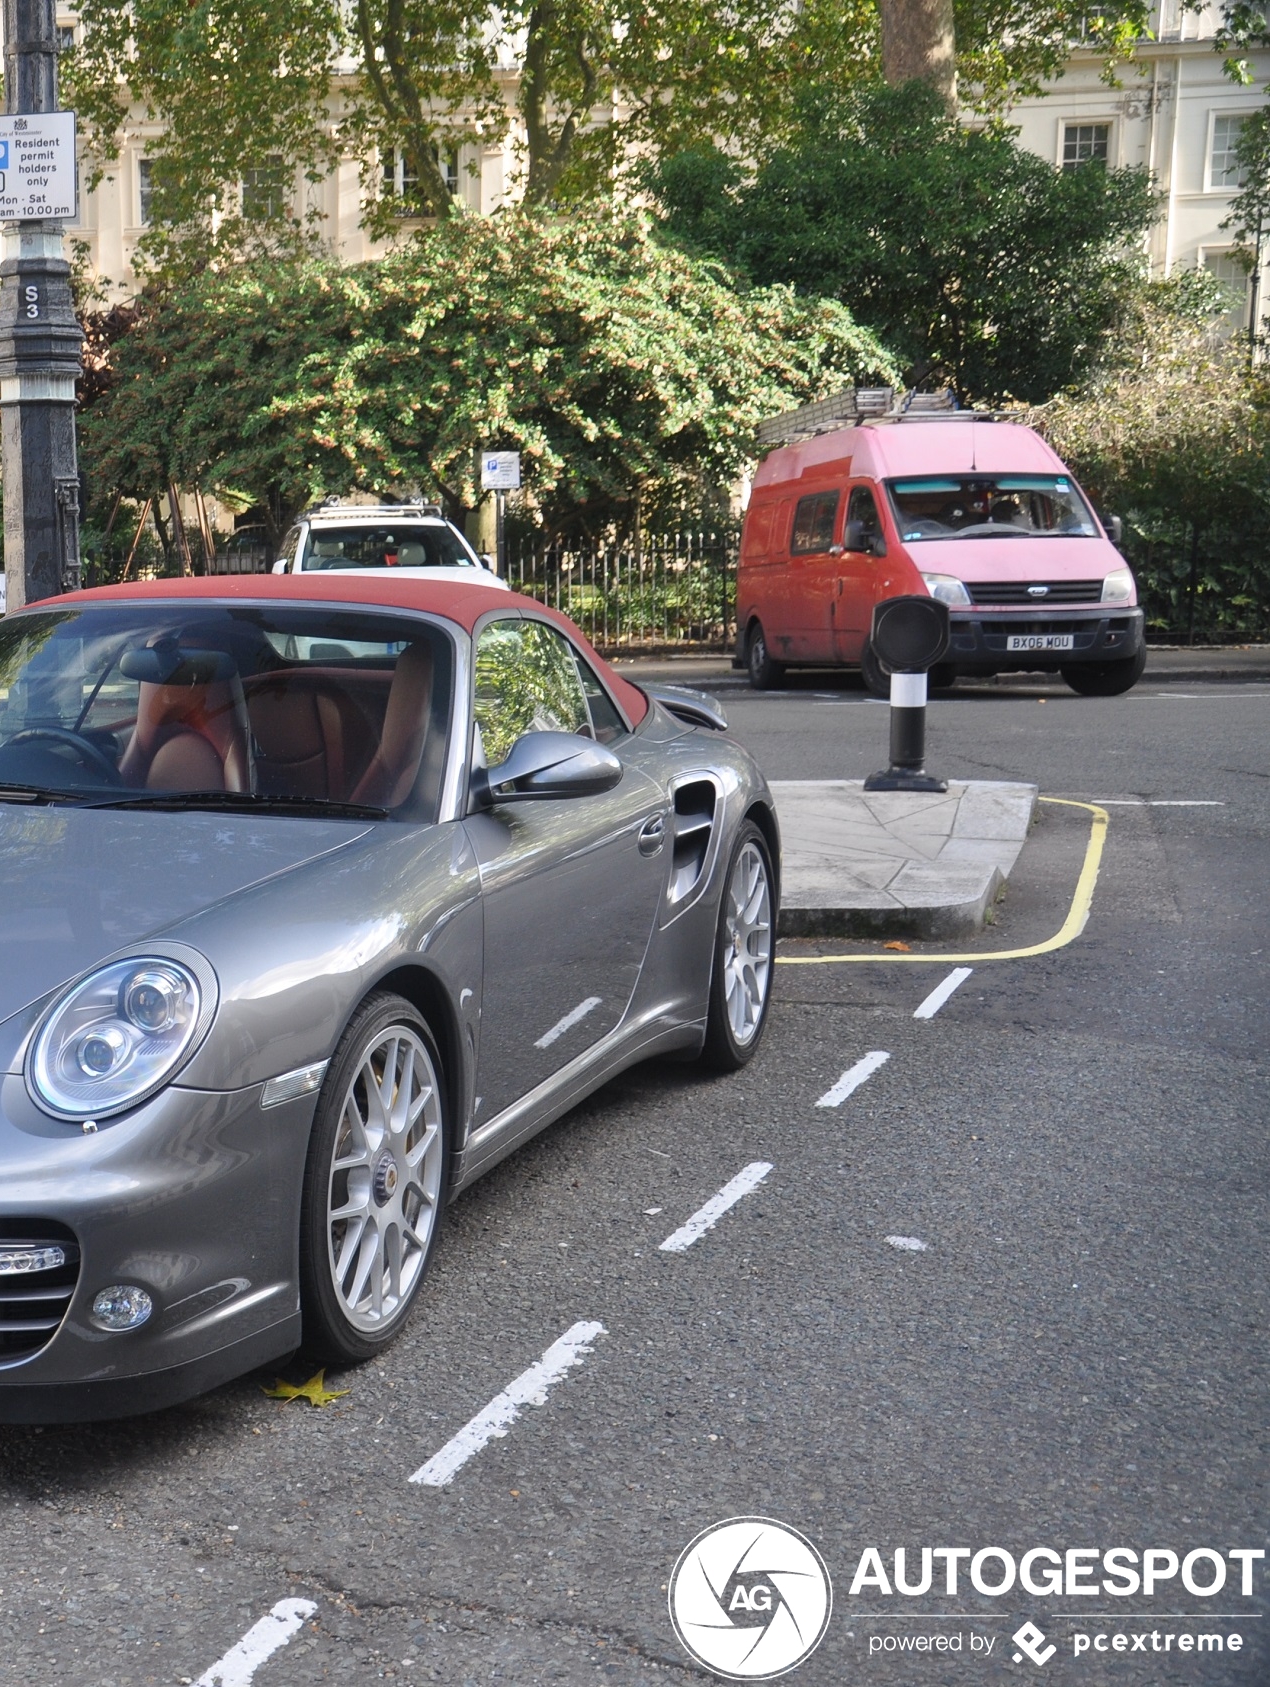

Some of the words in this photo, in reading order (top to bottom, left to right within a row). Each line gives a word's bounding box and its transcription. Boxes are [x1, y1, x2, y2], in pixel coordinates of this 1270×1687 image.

[15, 137, 60, 149] Resident
[20, 151, 54, 162] permit
[18, 164, 57, 174] holders
[27, 176, 49, 187] only
[29, 194, 46, 203] Sat
[0, 209, 15, 217] am
[22, 205, 52, 215] 10.00
[54, 206, 69, 215] pm
[1013, 637, 1043, 649] BX06
